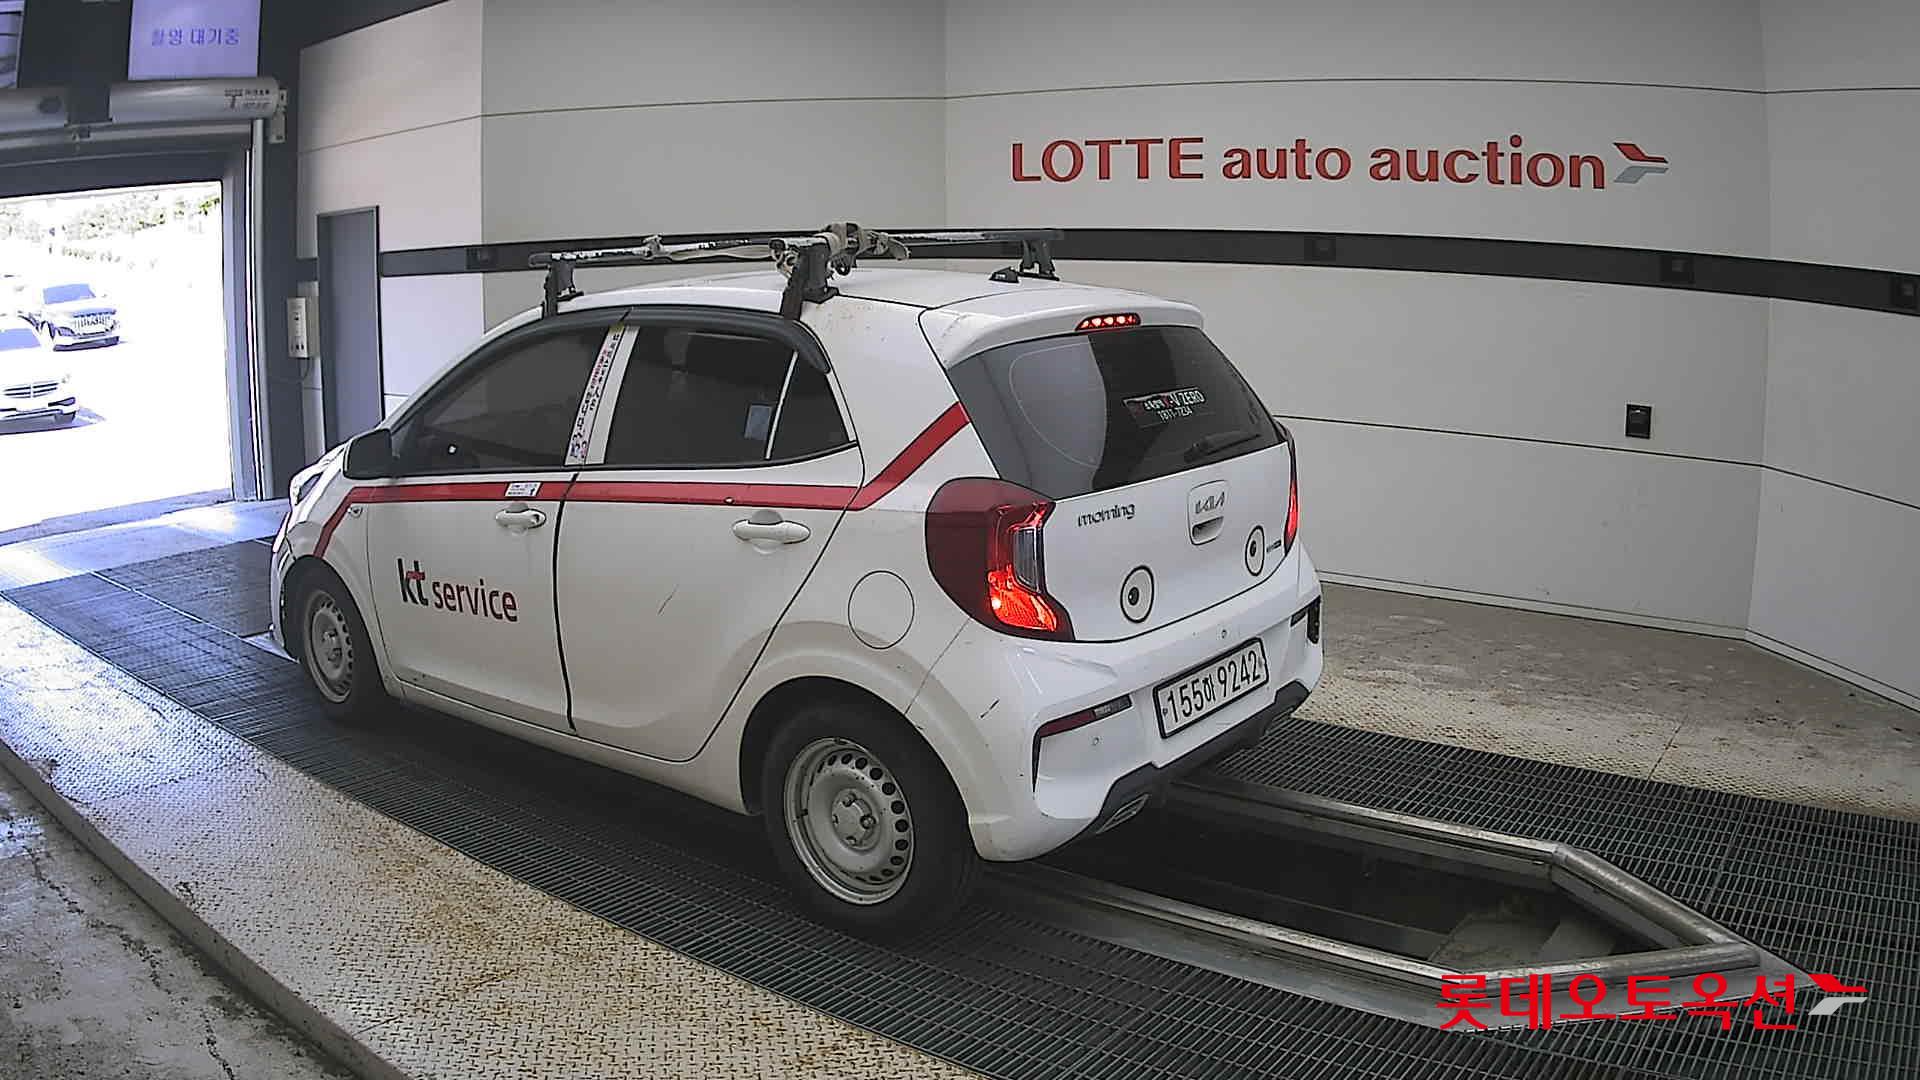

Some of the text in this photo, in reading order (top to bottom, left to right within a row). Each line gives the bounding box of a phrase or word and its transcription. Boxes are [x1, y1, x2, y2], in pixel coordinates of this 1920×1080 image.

[190, 27, 240, 46] 대기중
[1011, 135, 1606, 190] LOTTE auto auction
[1077, 503, 1136, 527] morning
[397, 558, 518, 622] kt service
